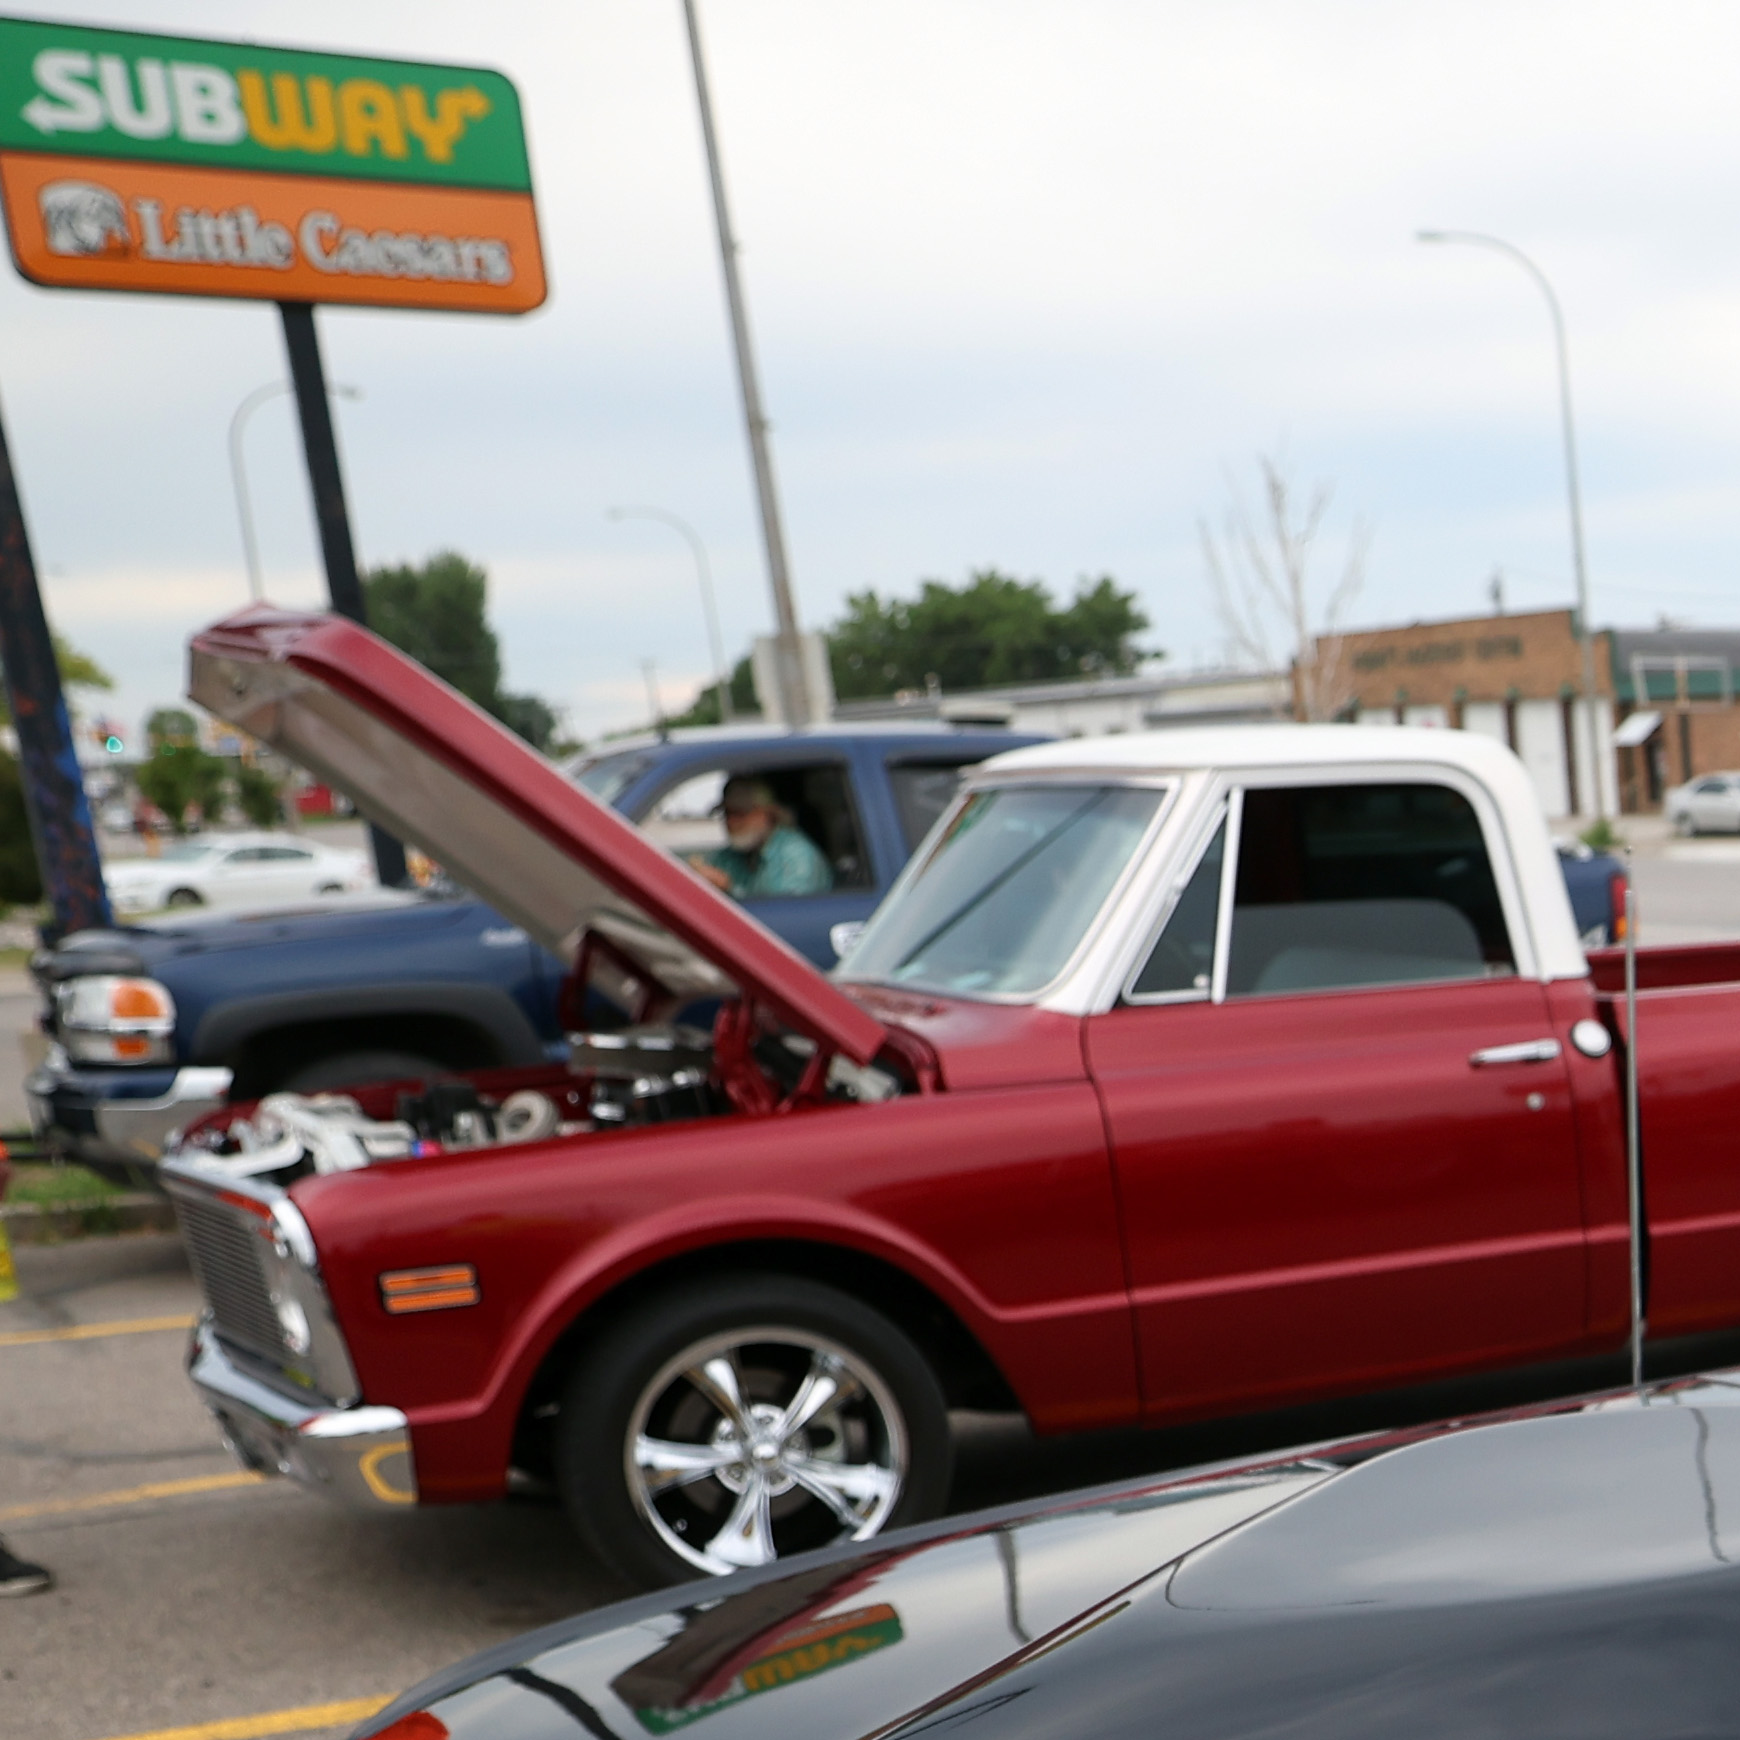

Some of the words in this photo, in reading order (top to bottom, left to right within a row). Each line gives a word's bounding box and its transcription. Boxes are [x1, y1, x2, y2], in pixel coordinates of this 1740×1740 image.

[22, 48, 492, 163] SUBWAY
[133, 198, 296, 268] Little
[300, 210, 514, 285] Caesars
